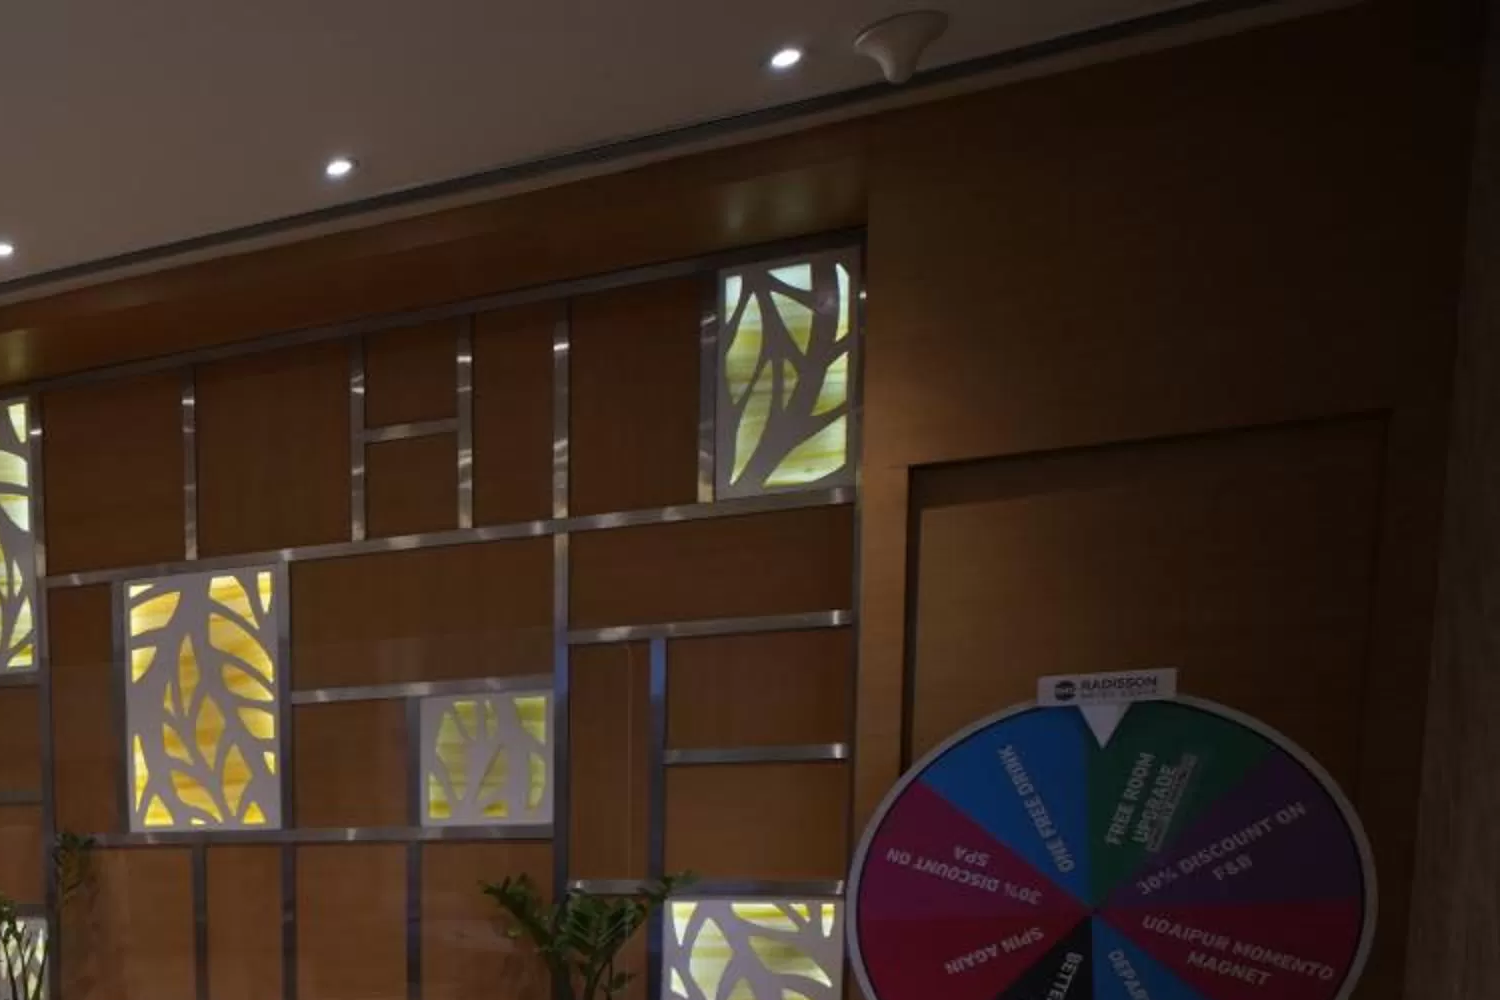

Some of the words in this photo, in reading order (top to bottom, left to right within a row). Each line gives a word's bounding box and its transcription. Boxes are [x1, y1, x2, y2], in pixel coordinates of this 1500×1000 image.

[998, 744, 1034, 796] DRINK
[1024, 793, 1057, 838] FREE
[1105, 803, 1135, 847] FREE
[1123, 752, 1156, 801] ROOM
[886, 847, 912, 865] ON
[953, 845, 989, 866] SPA
[1046, 836, 1075, 873] ONE
[1137, 868, 1178, 894] 30%
[1180, 817, 1272, 875] DISCOUNT
[1276, 801, 1306, 825] ON
[913, 856, 1000, 892] DISCOUNT
[1004, 883, 1042, 904] 30%
[1001, 927, 1044, 953] SPIN
[1142, 915, 1229, 949] UDAIPUR
[1231, 940, 1335, 981] MOMENTO
[944, 944, 997, 975] AGAIN
[1186, 951, 1272, 985] MAGNET
